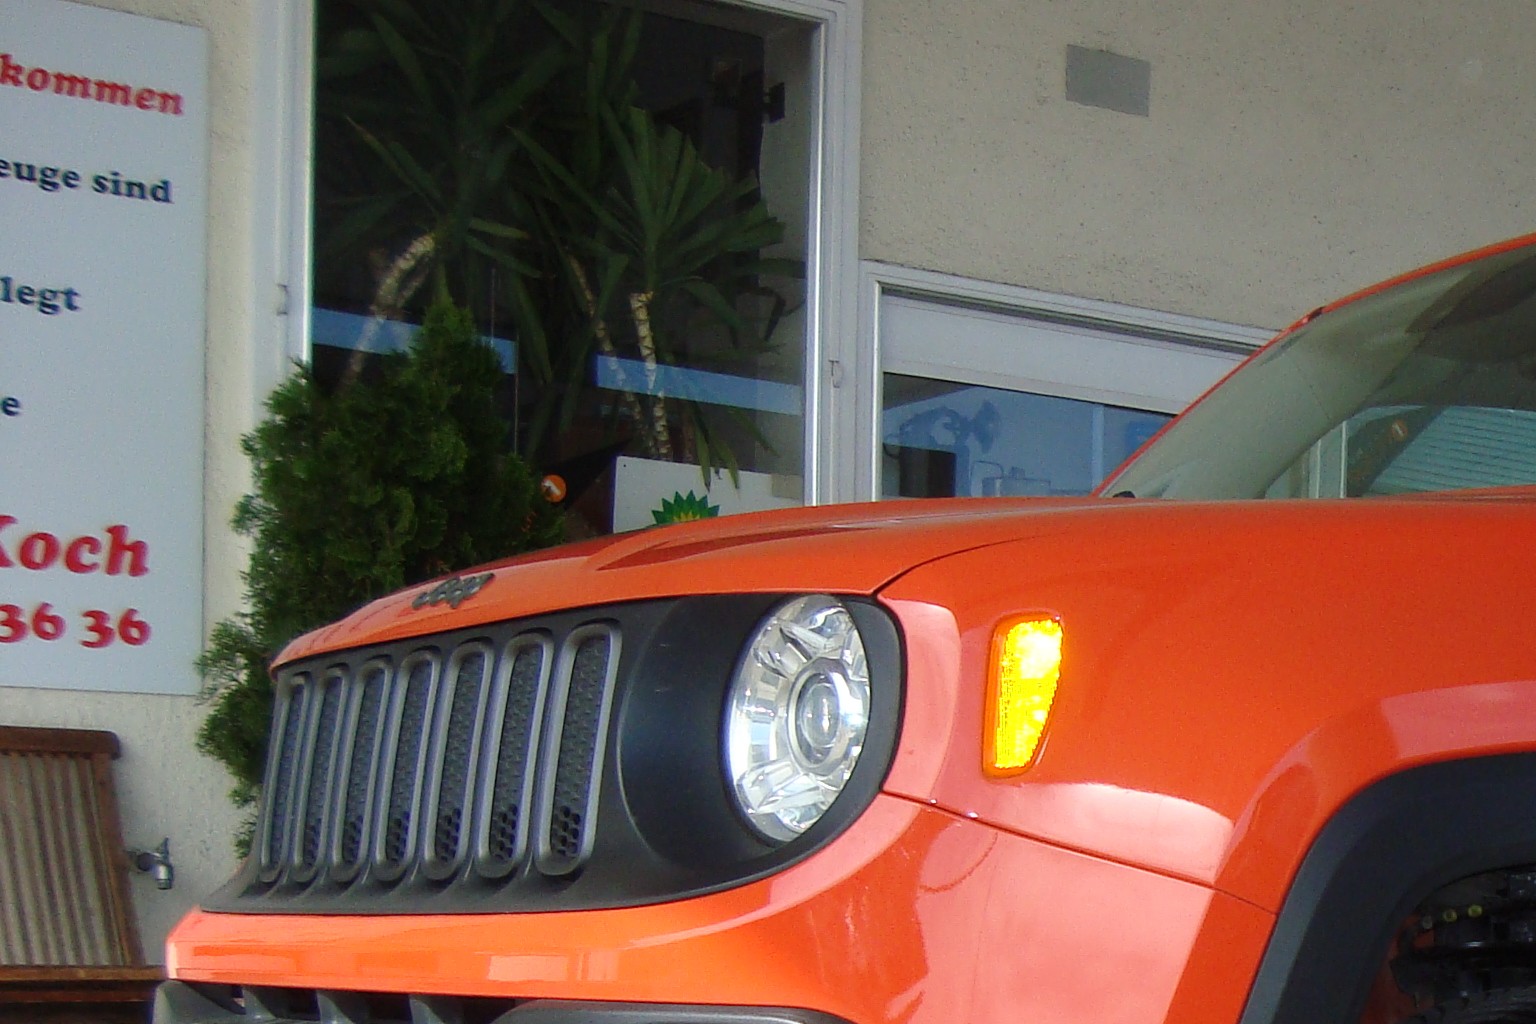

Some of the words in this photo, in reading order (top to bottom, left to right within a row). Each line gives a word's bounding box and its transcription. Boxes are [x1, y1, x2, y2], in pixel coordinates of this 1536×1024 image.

[0, 53, 184, 115] kommen
[92, 171, 174, 204] sind
[0, 276, 81, 315] legt
[1, 397, 21, 417] e
[0, 602, 66, 643] 36
[80, 608, 151, 648] 36
